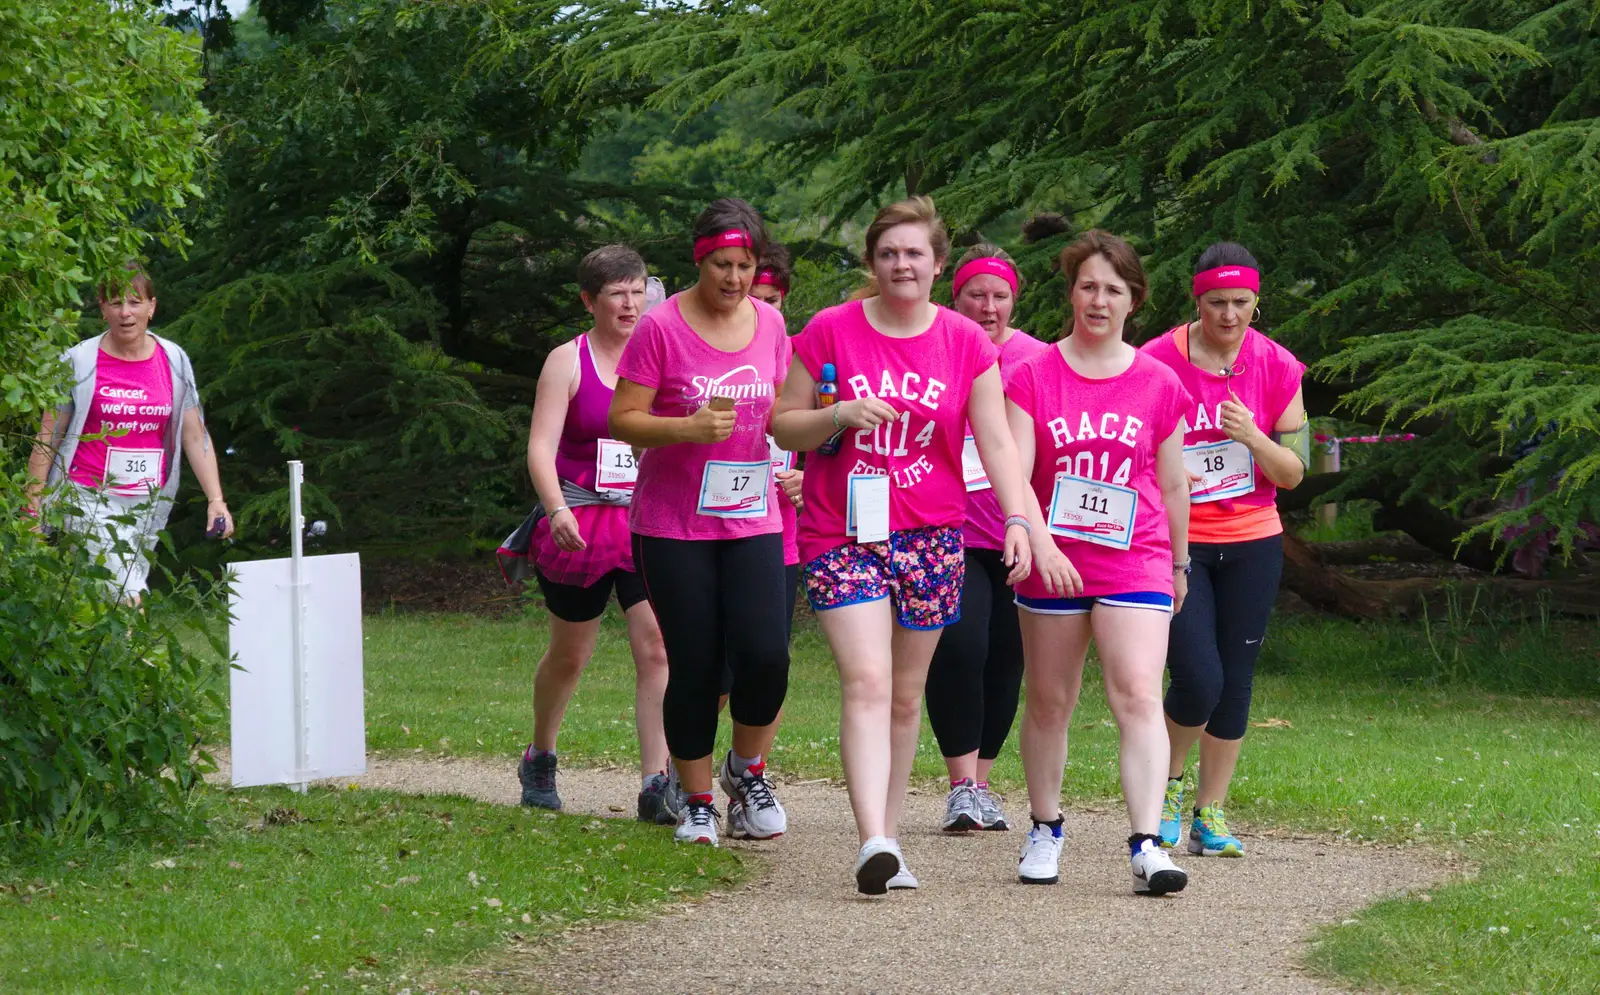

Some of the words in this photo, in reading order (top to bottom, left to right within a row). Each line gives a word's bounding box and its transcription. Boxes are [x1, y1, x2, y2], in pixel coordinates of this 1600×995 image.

[100, 386, 148, 400] Cancer,
[848, 370, 946, 410] RACE
[101, 402, 137, 415] we're
[140, 421, 160, 434] you
[855, 410, 936, 457] 2014
[1047, 411, 1144, 449] RACE
[125, 460, 147, 473] 316
[614, 453, 639, 469] 13
[1056, 451, 1132, 488] 2014
[1203, 455, 1225, 473] 18
[893, 454, 934, 489] LIFE
[731, 476, 751, 492] 17
[1079, 493, 1109, 515] 111
